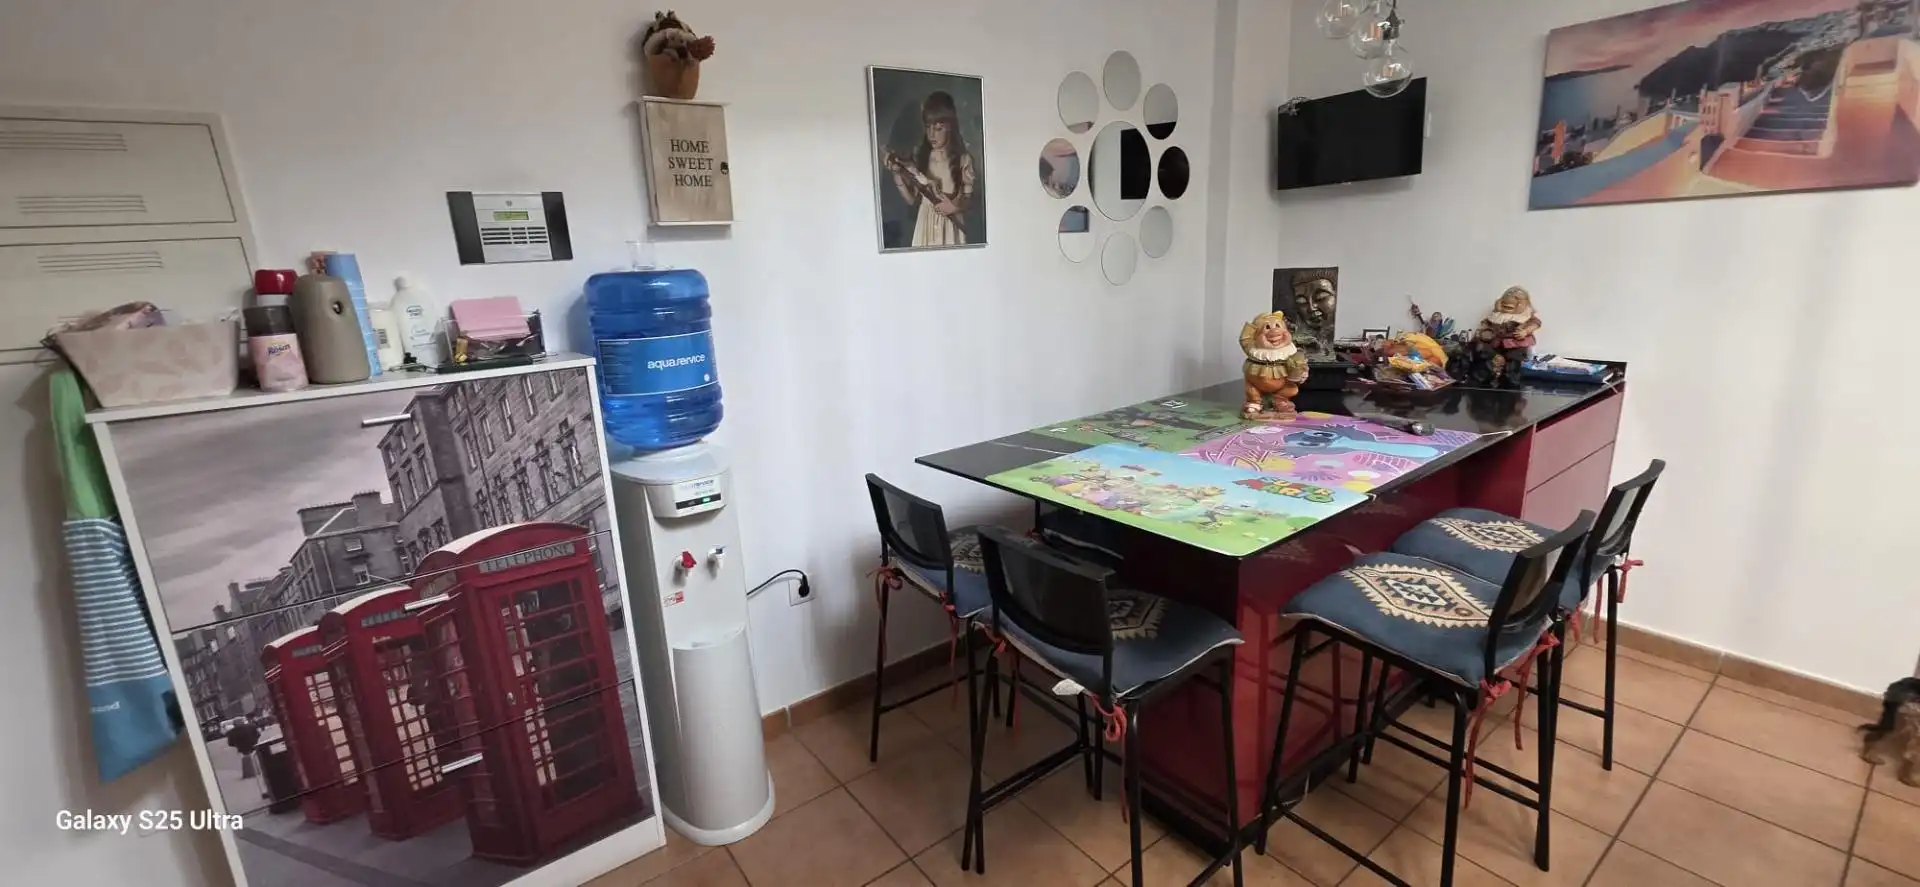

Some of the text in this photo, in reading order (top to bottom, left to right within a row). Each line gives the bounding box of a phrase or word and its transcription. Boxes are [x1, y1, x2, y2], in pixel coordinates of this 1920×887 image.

[670, 139, 710, 153] HOME
[668, 156, 714, 171] SWEET
[673, 174, 713, 187] HOME
[647, 354, 706, 371] aquaservice
[484, 545, 571, 571] TELEPHONE
